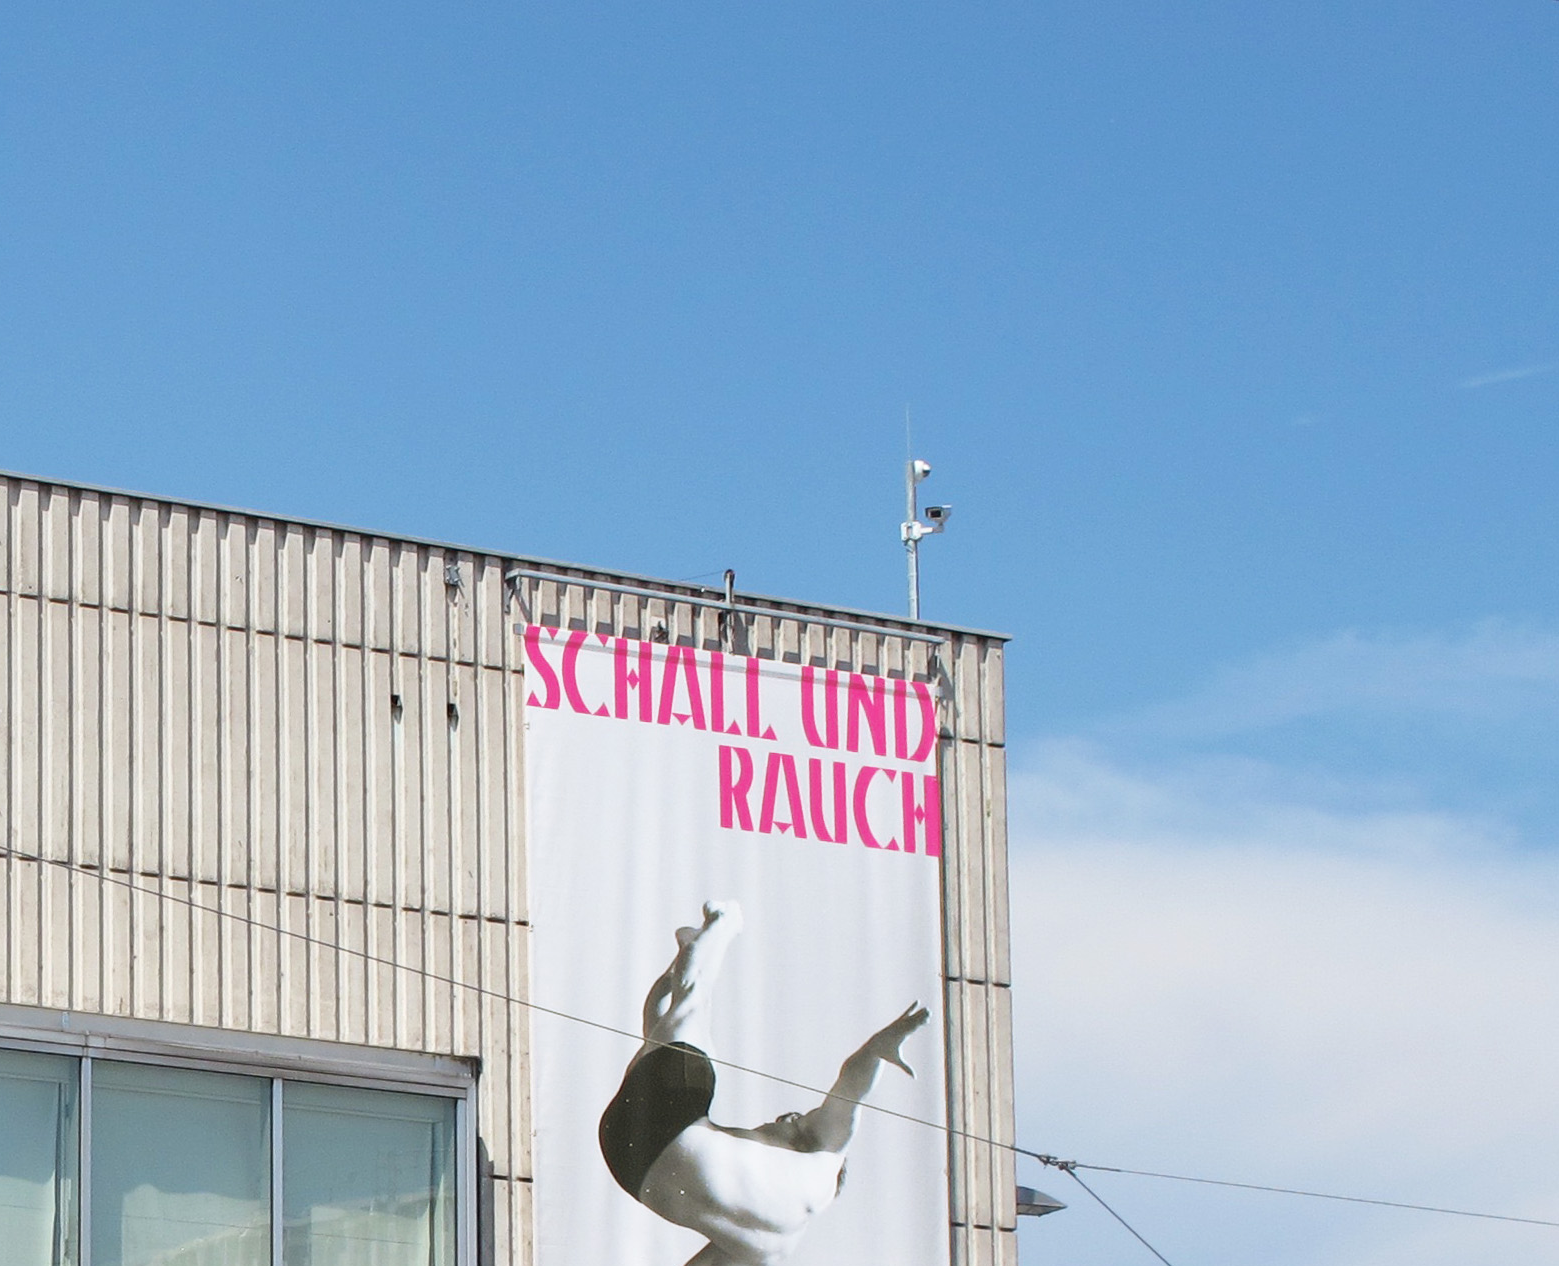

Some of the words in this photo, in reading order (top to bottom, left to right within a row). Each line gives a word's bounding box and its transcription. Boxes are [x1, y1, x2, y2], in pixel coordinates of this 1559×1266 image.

[524, 624, 778, 741] SCHALL
[800, 665, 936, 763] UND
[718, 744, 939, 857] RAUCH
